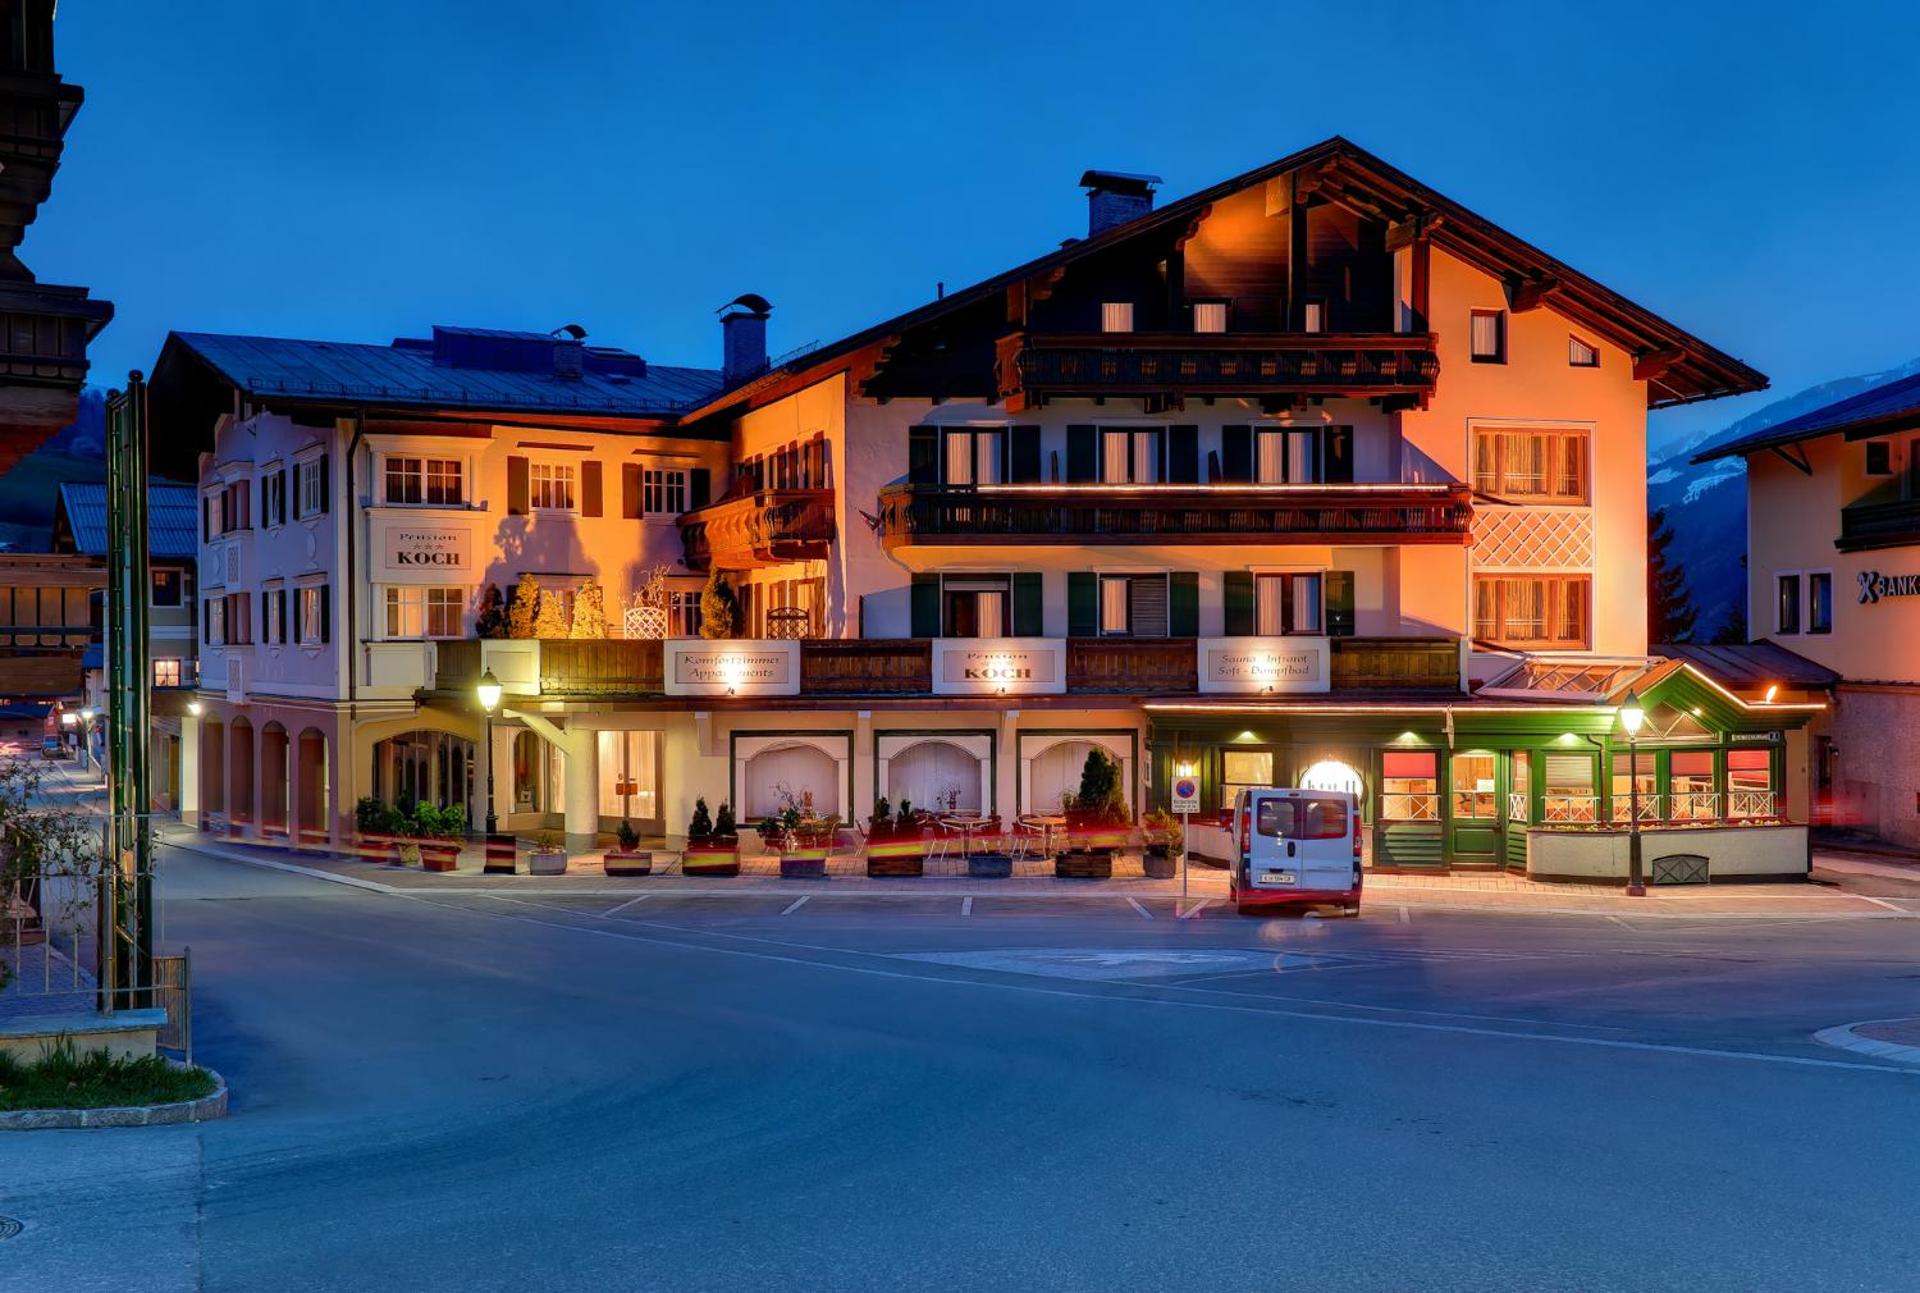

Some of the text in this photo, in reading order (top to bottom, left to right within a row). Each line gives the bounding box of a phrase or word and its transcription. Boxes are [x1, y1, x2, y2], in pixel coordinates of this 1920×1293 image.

[400, 533, 457, 541] Pension
[397, 551, 461, 566] KOCH
[684, 655, 780, 666] Komfortzimmer
[1221, 654, 1257, 664] Sauna
[688, 668, 775, 680] Appaments
[965, 668, 1031, 679] KOCH
[1217, 666, 1240, 677] Soft
